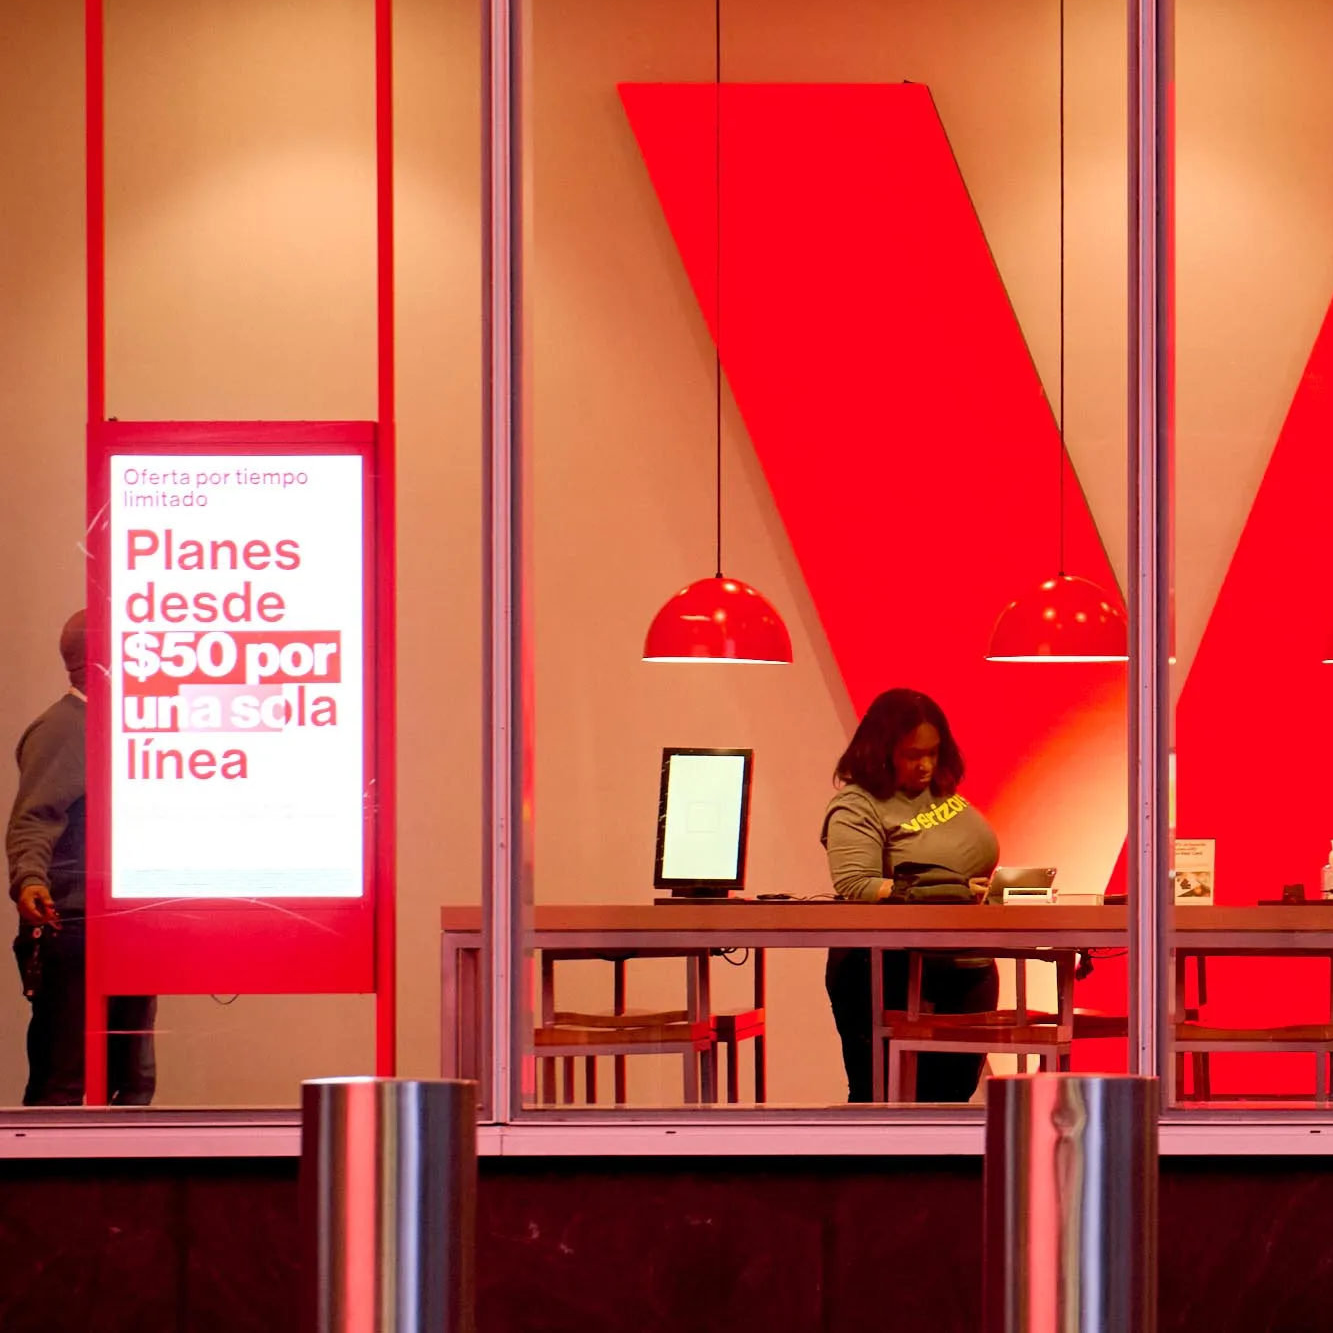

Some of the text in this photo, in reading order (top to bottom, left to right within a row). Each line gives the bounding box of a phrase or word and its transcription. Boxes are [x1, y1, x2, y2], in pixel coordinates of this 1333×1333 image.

[123, 468, 309, 489] Oferta por tiempo
[123, 491, 208, 507] limitado
[126, 529, 301, 571] Planes
[125, 581, 286, 623] desde
[123, 631, 337, 684] $50 por
[124, 685, 337, 730] una sola
[127, 738, 248, 779] línea
